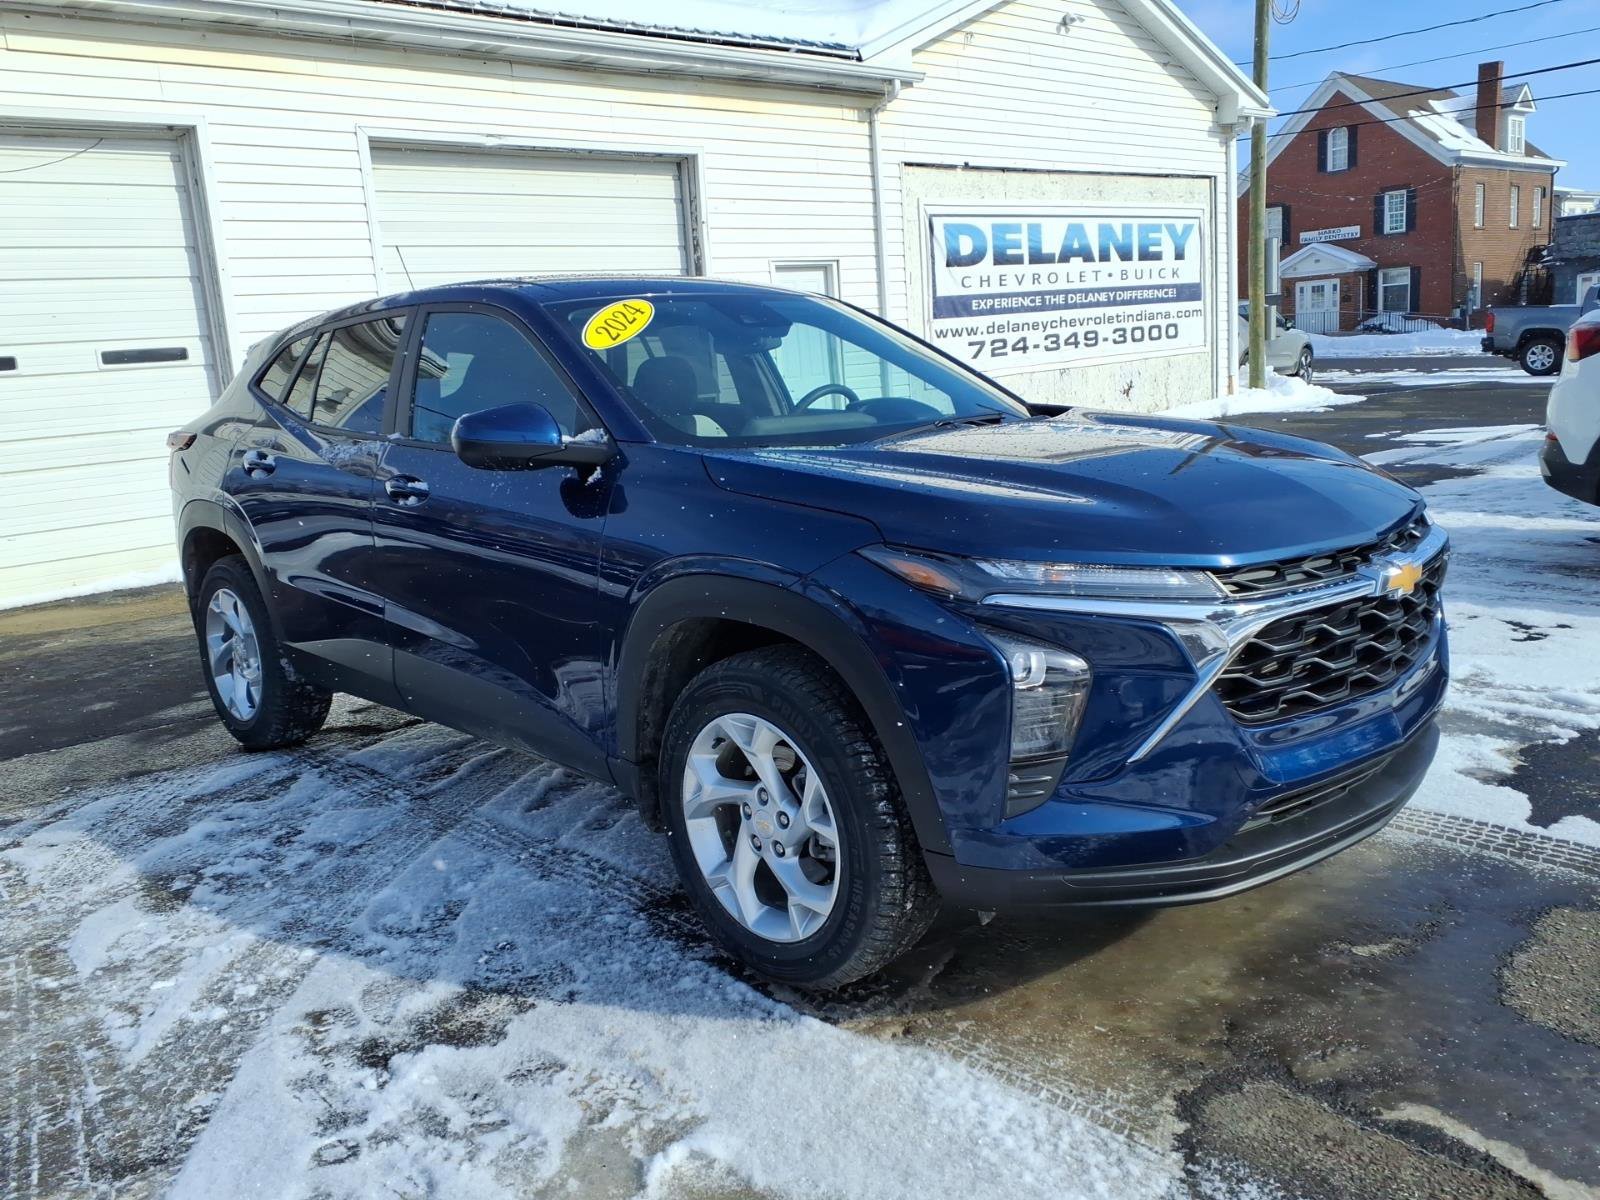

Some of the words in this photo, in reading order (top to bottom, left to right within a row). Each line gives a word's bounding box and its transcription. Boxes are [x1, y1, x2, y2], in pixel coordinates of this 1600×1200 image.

[943, 223, 1194, 267] DELANEY
[1324, 232, 1358, 240] DENTISTRY
[972, 296, 1042, 310] EXPERIENCE
[1044, 294, 1066, 305] THE
[1068, 291, 1115, 304] DELANEY
[1116, 288, 1177, 301] DIFFERENCE!
[595, 303, 645, 341] 2024
[935, 308, 1202, 338] www.delaneychevroletindiana.com
[968, 323, 1179, 359] 724-349-3000
